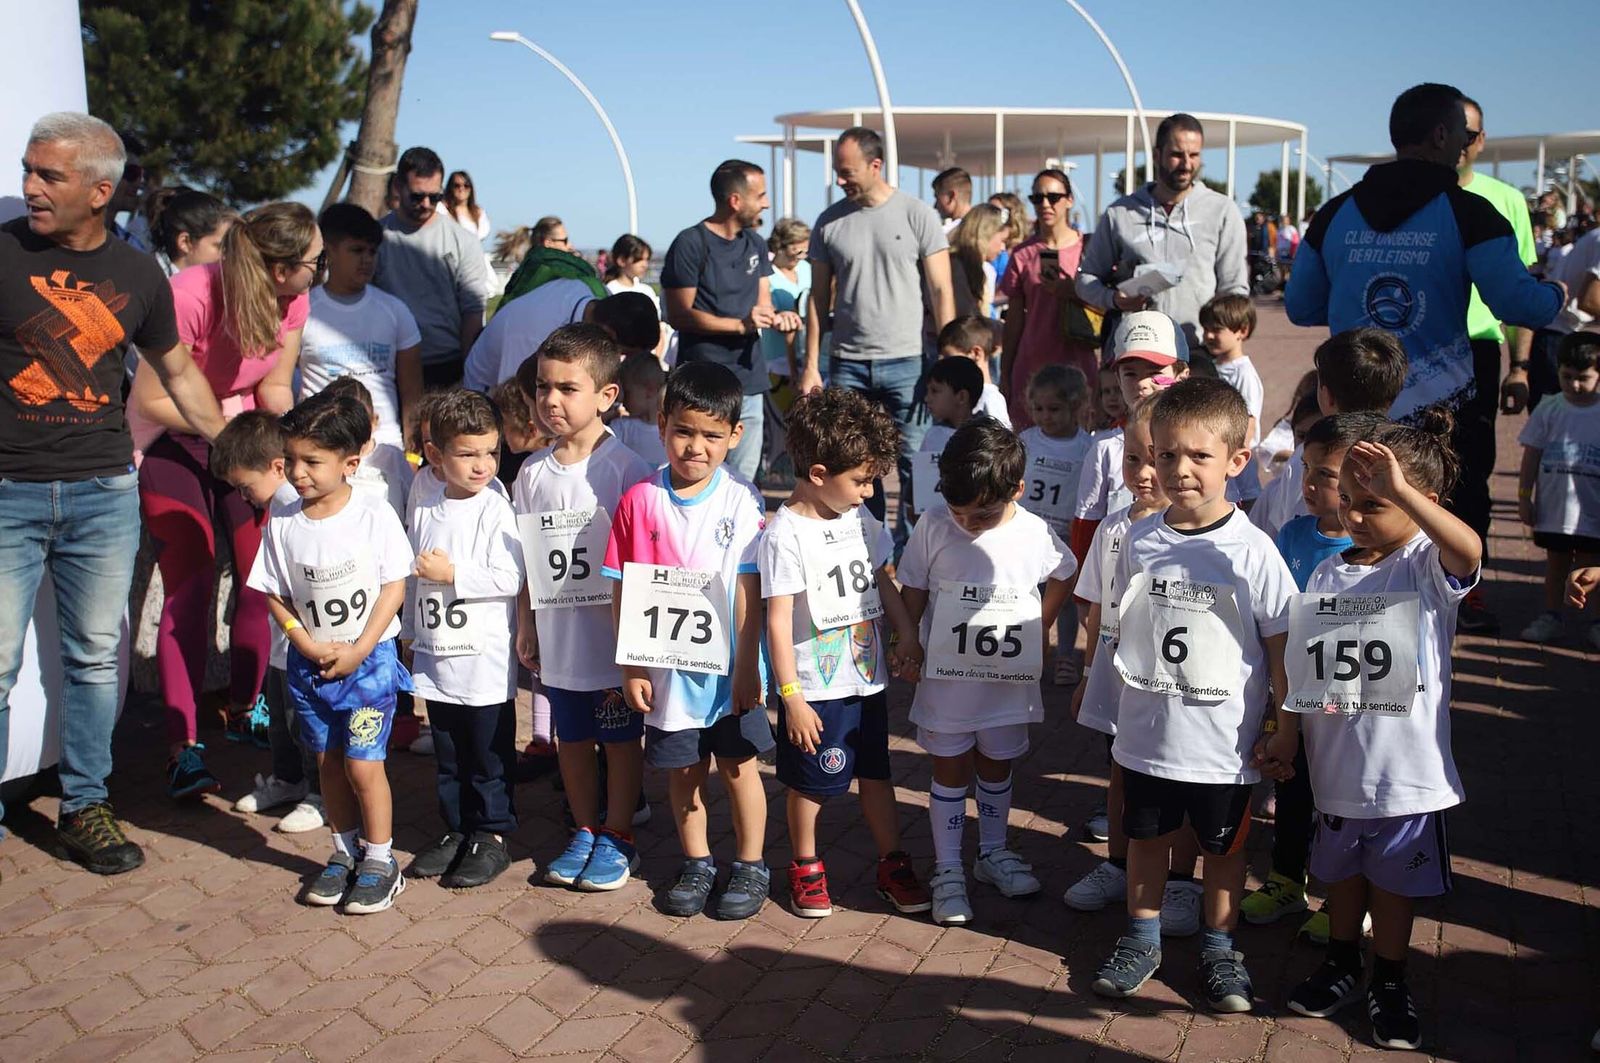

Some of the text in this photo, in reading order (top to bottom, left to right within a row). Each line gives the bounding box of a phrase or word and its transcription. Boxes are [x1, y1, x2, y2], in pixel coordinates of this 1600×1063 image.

[1345, 231, 1377, 246] CLUB
[1029, 479, 1061, 505] 31
[541, 515, 553, 527] H
[548, 547, 591, 581] 95
[303, 567, 315, 579] H
[653, 569, 668, 581] H
[827, 559, 877, 597] 18
[682, 578, 711, 586] HUELVA
[1151, 578, 1168, 593] H
[962, 585, 977, 598] H
[1182, 590, 1217, 601] HUELVA
[305, 588, 368, 628] 199
[1319, 597, 1337, 611] H
[1353, 603, 1386, 611] HUELVA
[418, 597, 468, 630] 136
[822, 614, 850, 624] Huelva
[643, 605, 713, 645] 173
[951, 622, 1023, 658] 165
[1161, 626, 1188, 664] 6
[435, 644, 446, 652] tus
[626, 652, 654, 663] Huelva
[677, 658, 689, 667] tus
[690, 659, 723, 671] sentidos.
[1306, 639, 1392, 681] 159
[936, 667, 964, 677] Huelva
[987, 671, 999, 679] tus
[1000, 672, 1035, 681] sentidos.
[1121, 669, 1231, 697] Huelva eleva tus sentidos.
[1295, 698, 1323, 708] Huelva
[1351, 701, 1367, 710] tus
[1369, 702, 1407, 713] sentidos.
